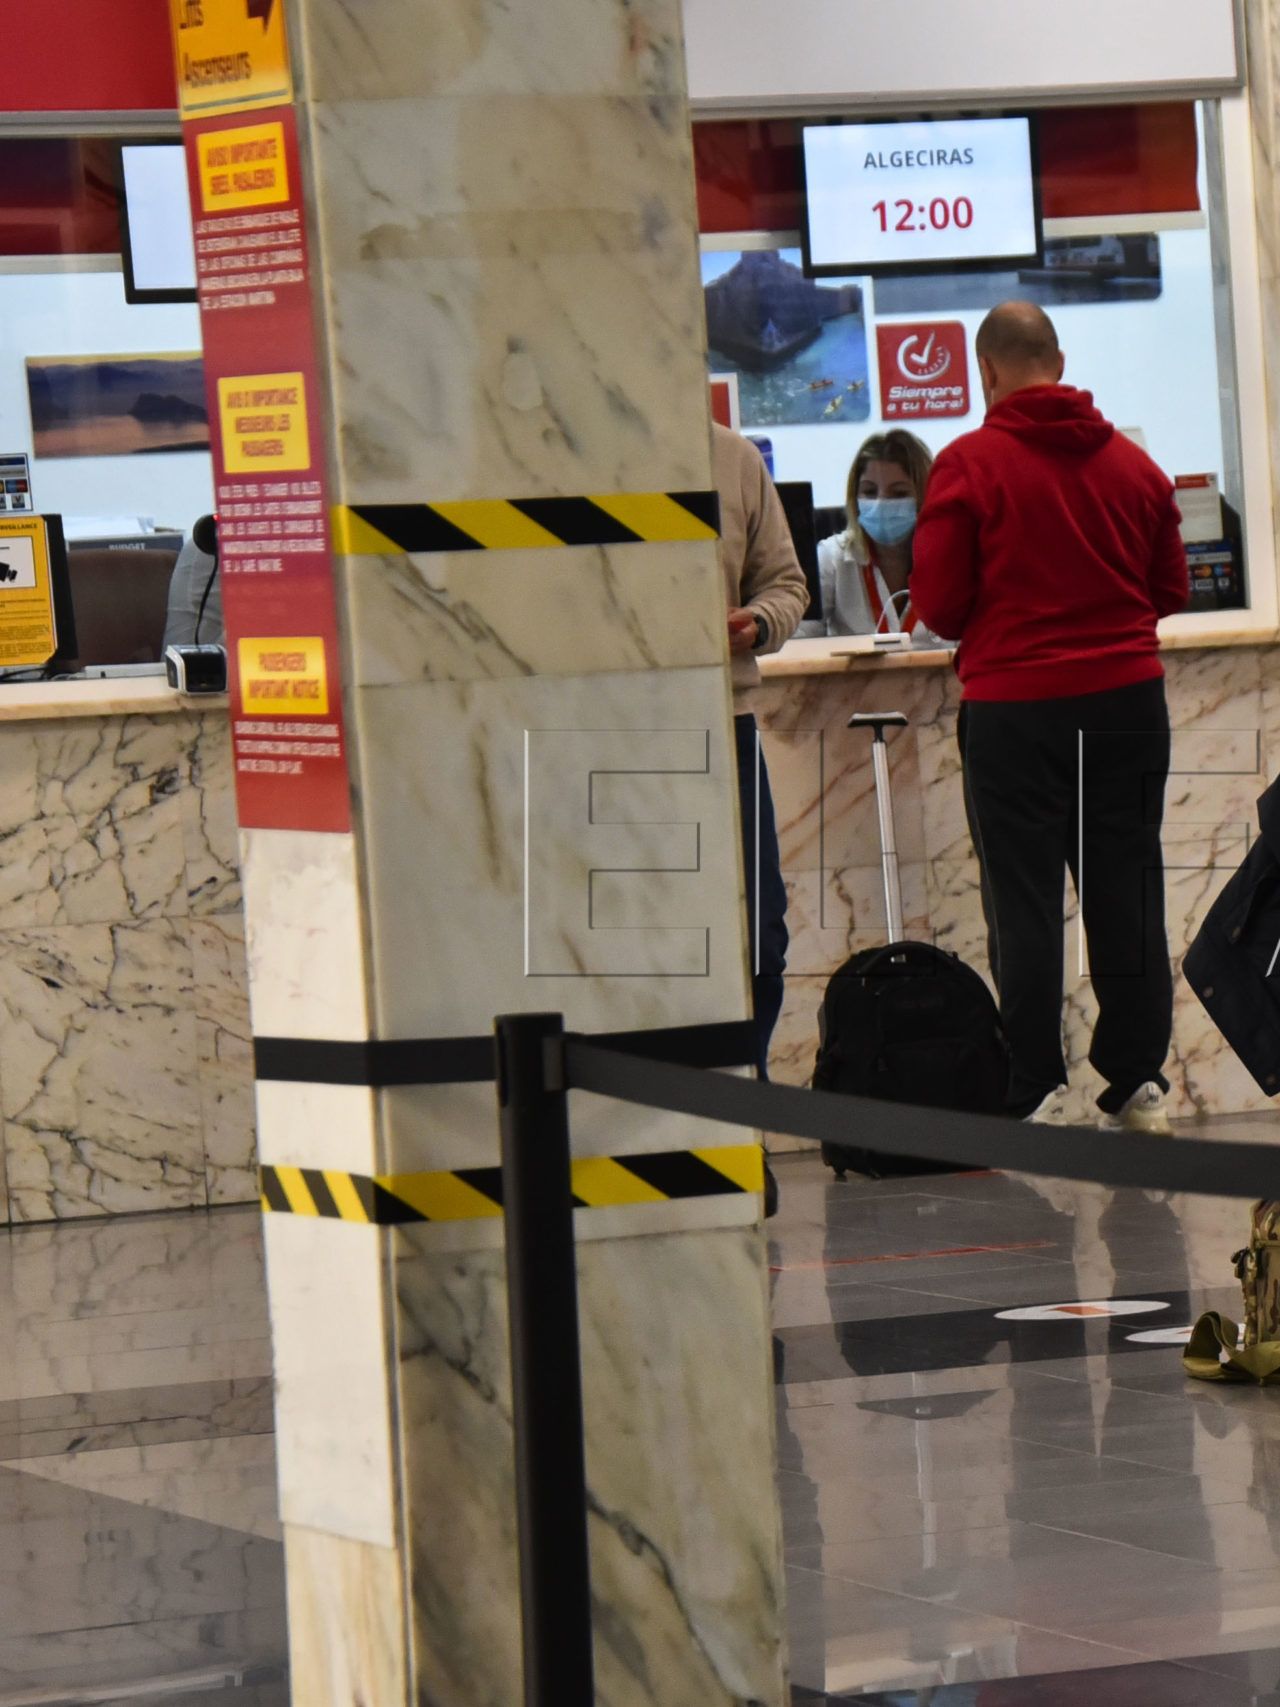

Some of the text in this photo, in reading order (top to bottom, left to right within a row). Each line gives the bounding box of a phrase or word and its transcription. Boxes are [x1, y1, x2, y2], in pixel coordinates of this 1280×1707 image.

[864, 148, 974, 169] ALGECIRAS
[872, 196, 974, 232] 12:00
[889, 385, 963, 399] Siempre
[902, 400, 919, 411] tu
